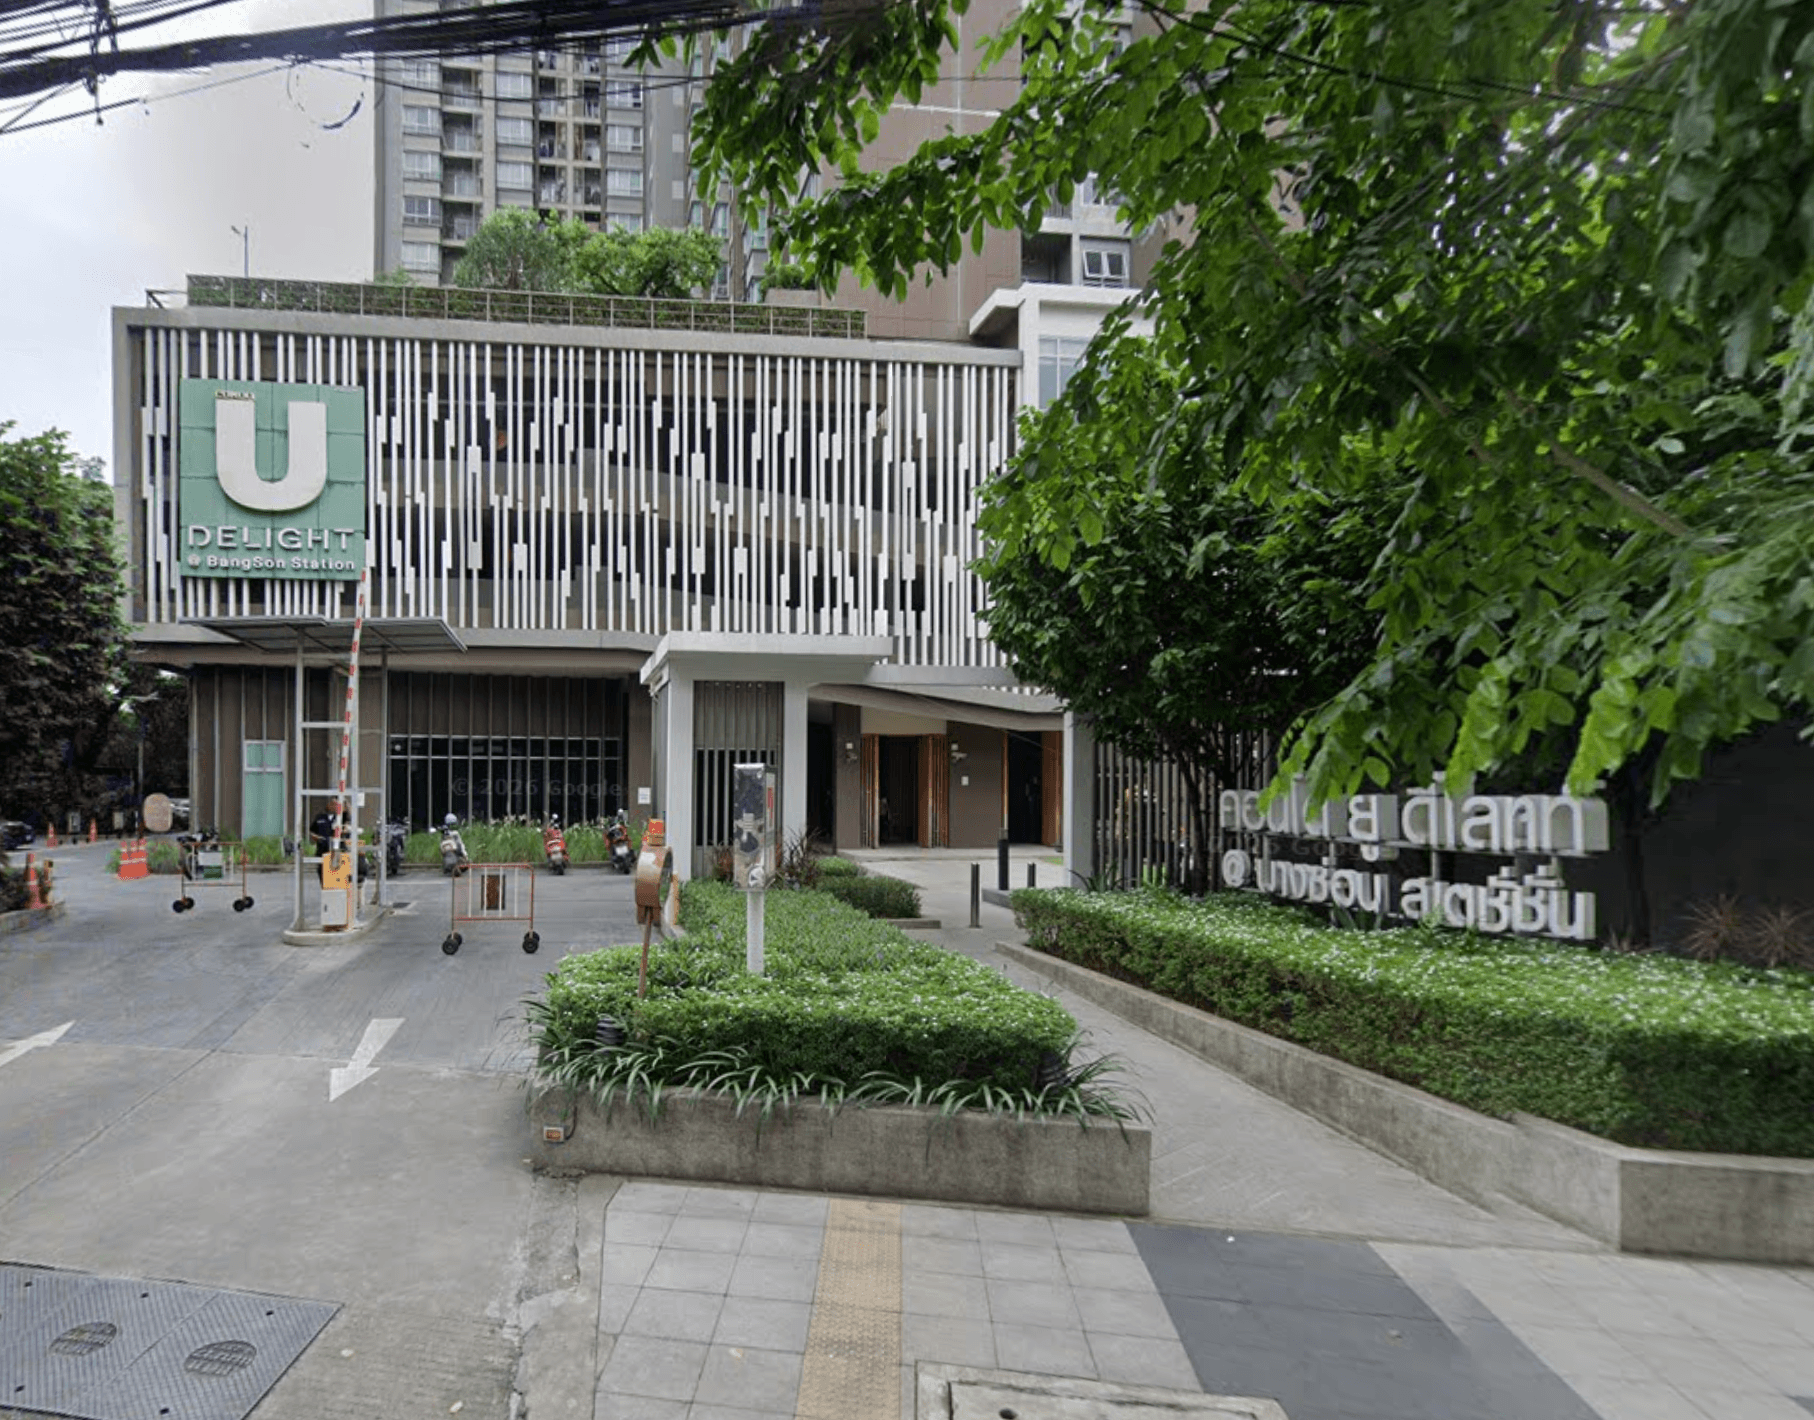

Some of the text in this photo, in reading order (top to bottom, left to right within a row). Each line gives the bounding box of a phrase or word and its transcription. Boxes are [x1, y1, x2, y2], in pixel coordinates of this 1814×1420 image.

[215, 397, 328, 512] U
[188, 525, 354, 550] DELIGHT
[206, 554, 287, 572] BangSon
[291, 556, 356, 573] Station
[1221, 848, 1251, 889] @
